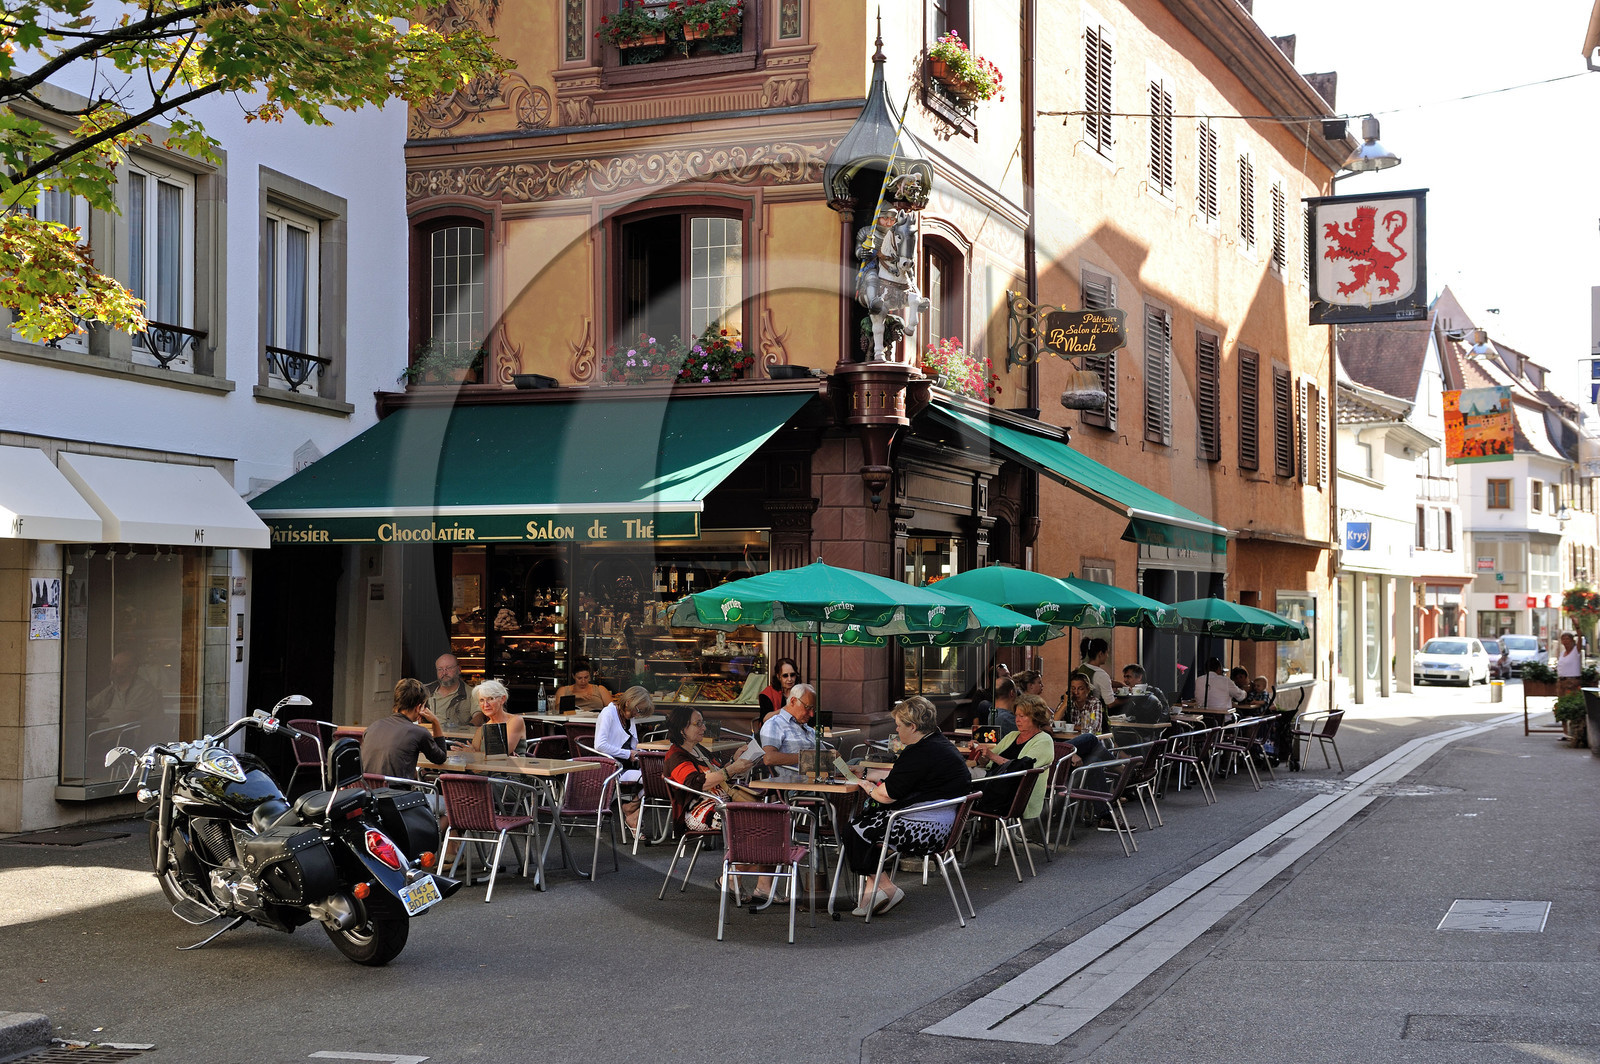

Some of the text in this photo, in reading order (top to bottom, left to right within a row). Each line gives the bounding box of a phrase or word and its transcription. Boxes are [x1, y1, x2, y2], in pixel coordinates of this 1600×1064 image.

[1082, 313, 1118, 324] Pâtissier
[1066, 322, 1120, 335] Salon de Thé
[622, 518, 656, 540] Thé
[1347, 530, 1367, 543] Krys
